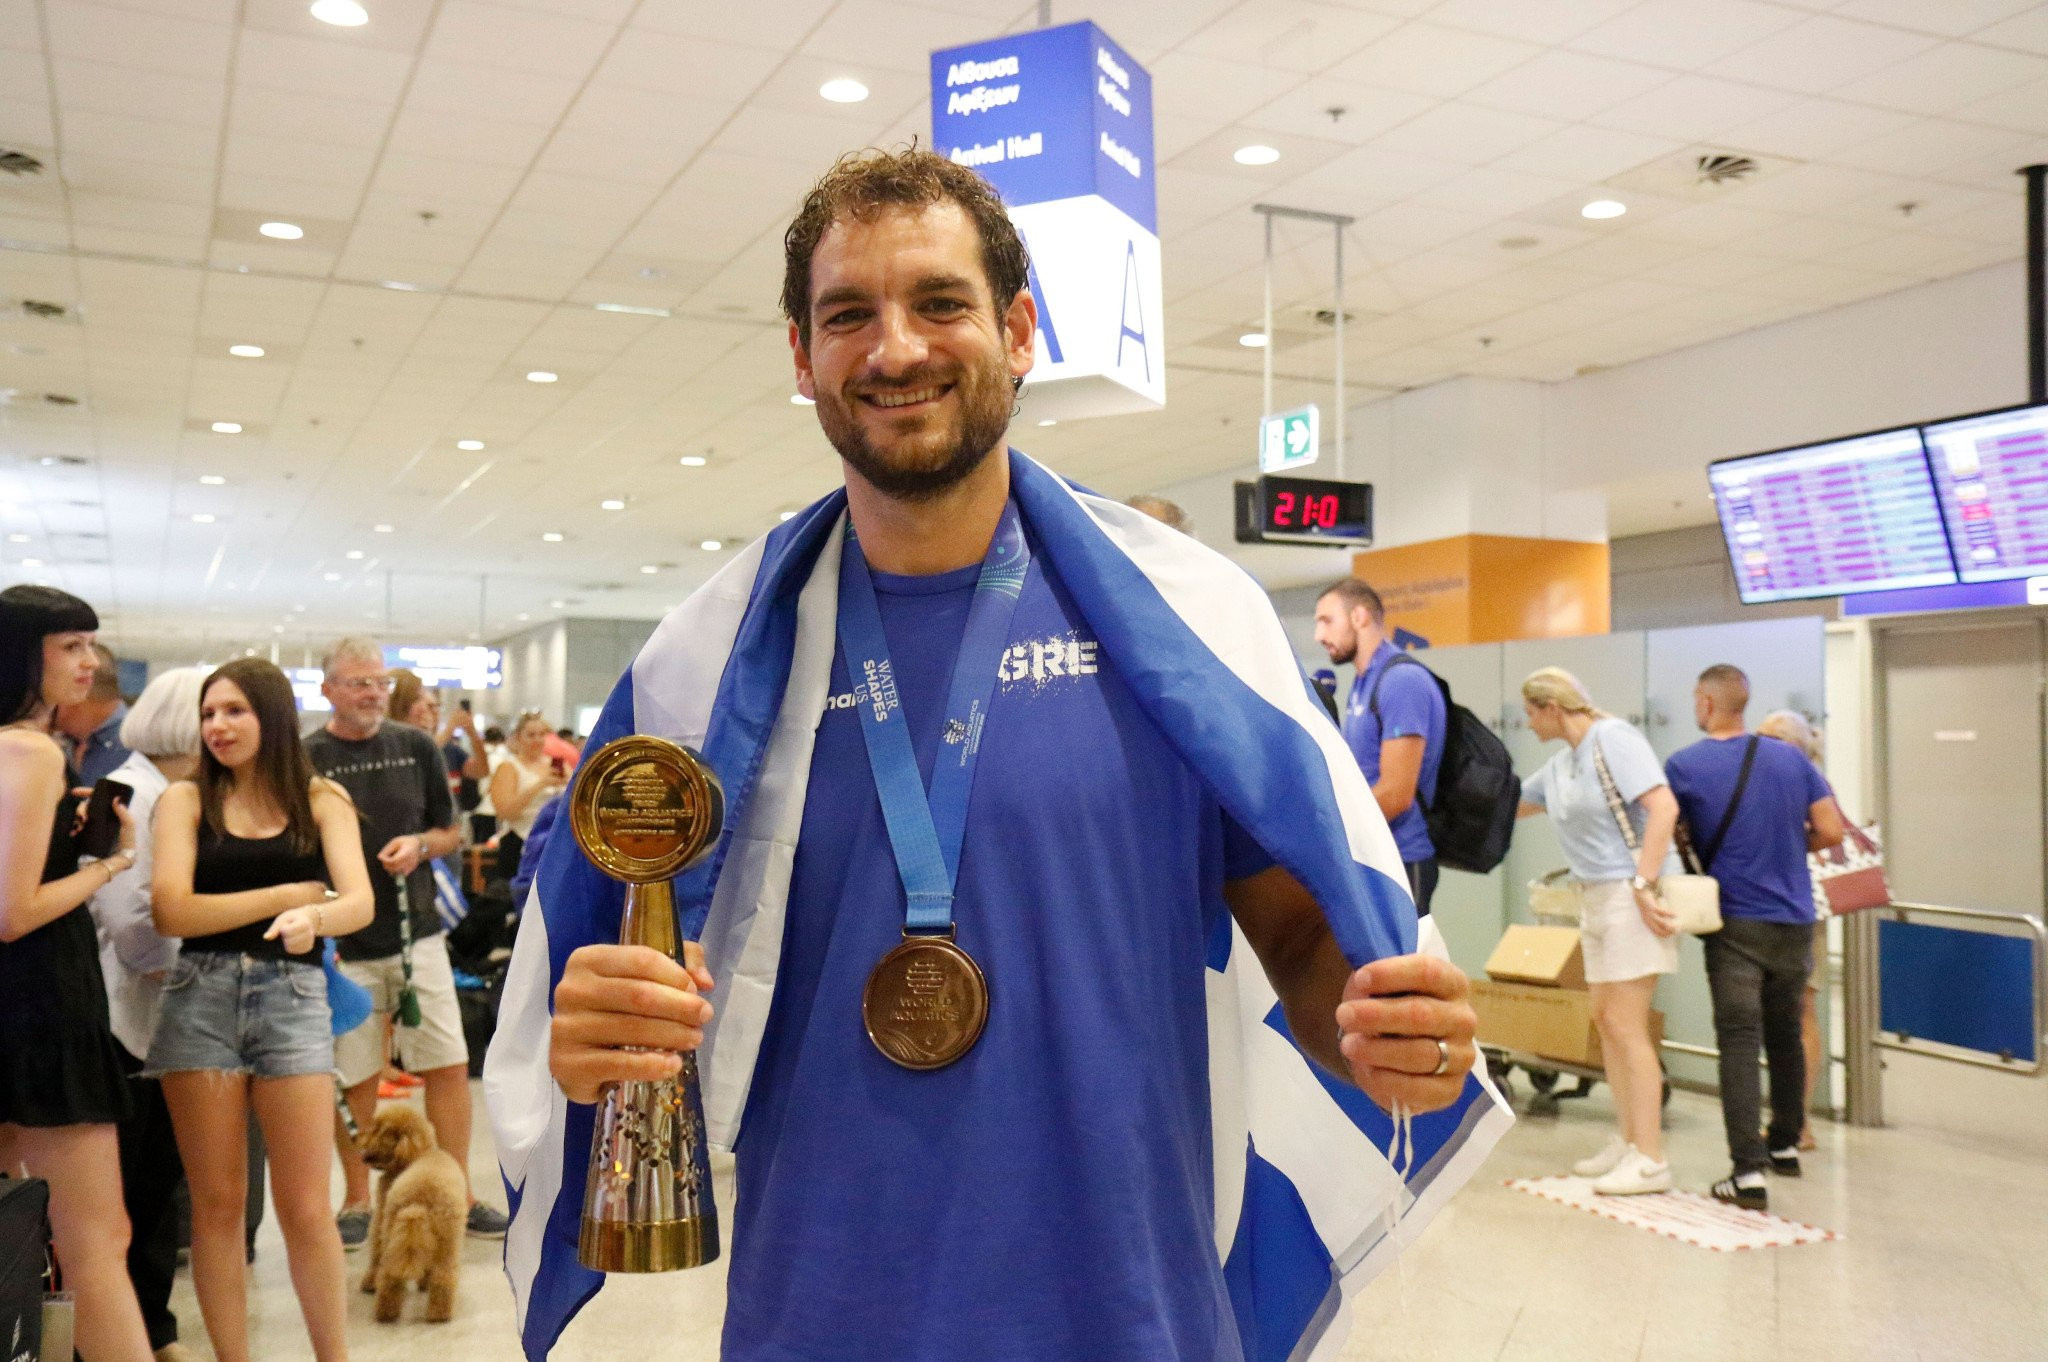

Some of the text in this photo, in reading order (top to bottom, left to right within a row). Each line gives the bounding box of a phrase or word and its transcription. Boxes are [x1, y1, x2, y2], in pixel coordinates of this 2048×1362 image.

[951, 132, 1043, 166] Arrival Hall
[1118, 239, 1150, 383] A
[878, 659, 899, 711] WATER
[998, 638, 1098, 682] GRE
[854, 683, 869, 703] US
[863, 659, 888, 722] SHAPES
[960, 699, 980, 767] WORLD AQUATICS
